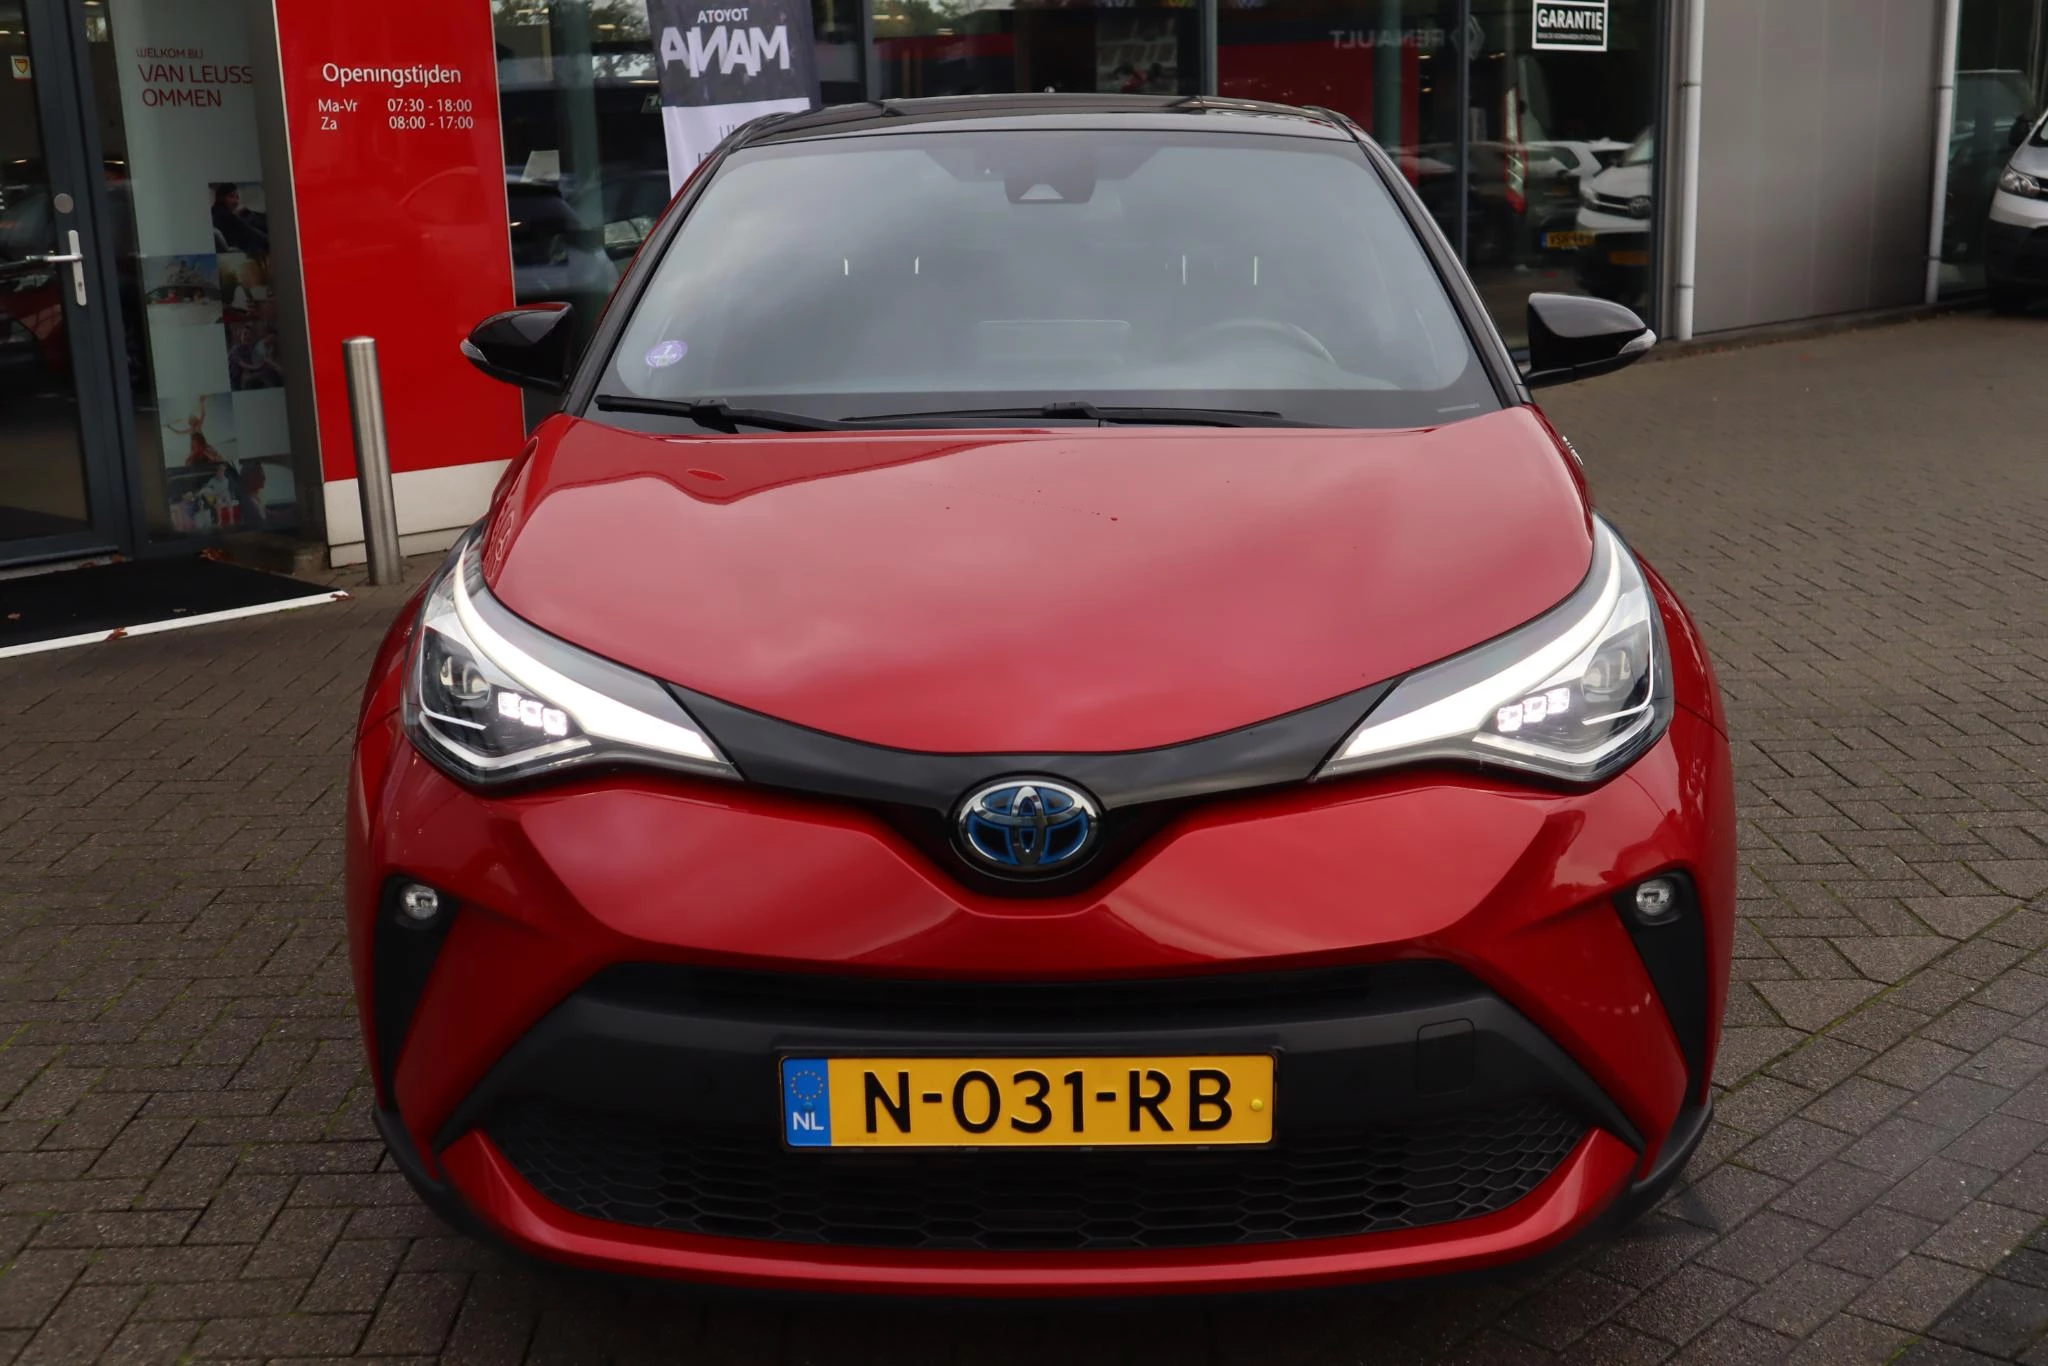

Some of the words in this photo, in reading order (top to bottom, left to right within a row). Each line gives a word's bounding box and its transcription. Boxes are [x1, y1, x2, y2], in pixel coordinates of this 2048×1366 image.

[1537, 8, 1603, 30] GARANTIE
[136, 47, 186, 59] WELKOM
[187, 48, 204, 59] BIJ
[138, 64, 184, 82] VAN
[189, 65, 254, 84] LEUSS
[322, 63, 462, 88] Openingstijden
[142, 88, 222, 107] OMMEN
[318, 99, 358, 112] Ma-Vr
[387, 98, 424, 112] 07:30
[438, 98, 473, 112] 18:00
[321, 116, 338, 130] Za
[389, 116, 426, 129] 08:00
[439, 116, 474, 129] 17:00
[864, 1069, 1233, 1134] N-031-RB
[792, 1111, 825, 1131] NL
